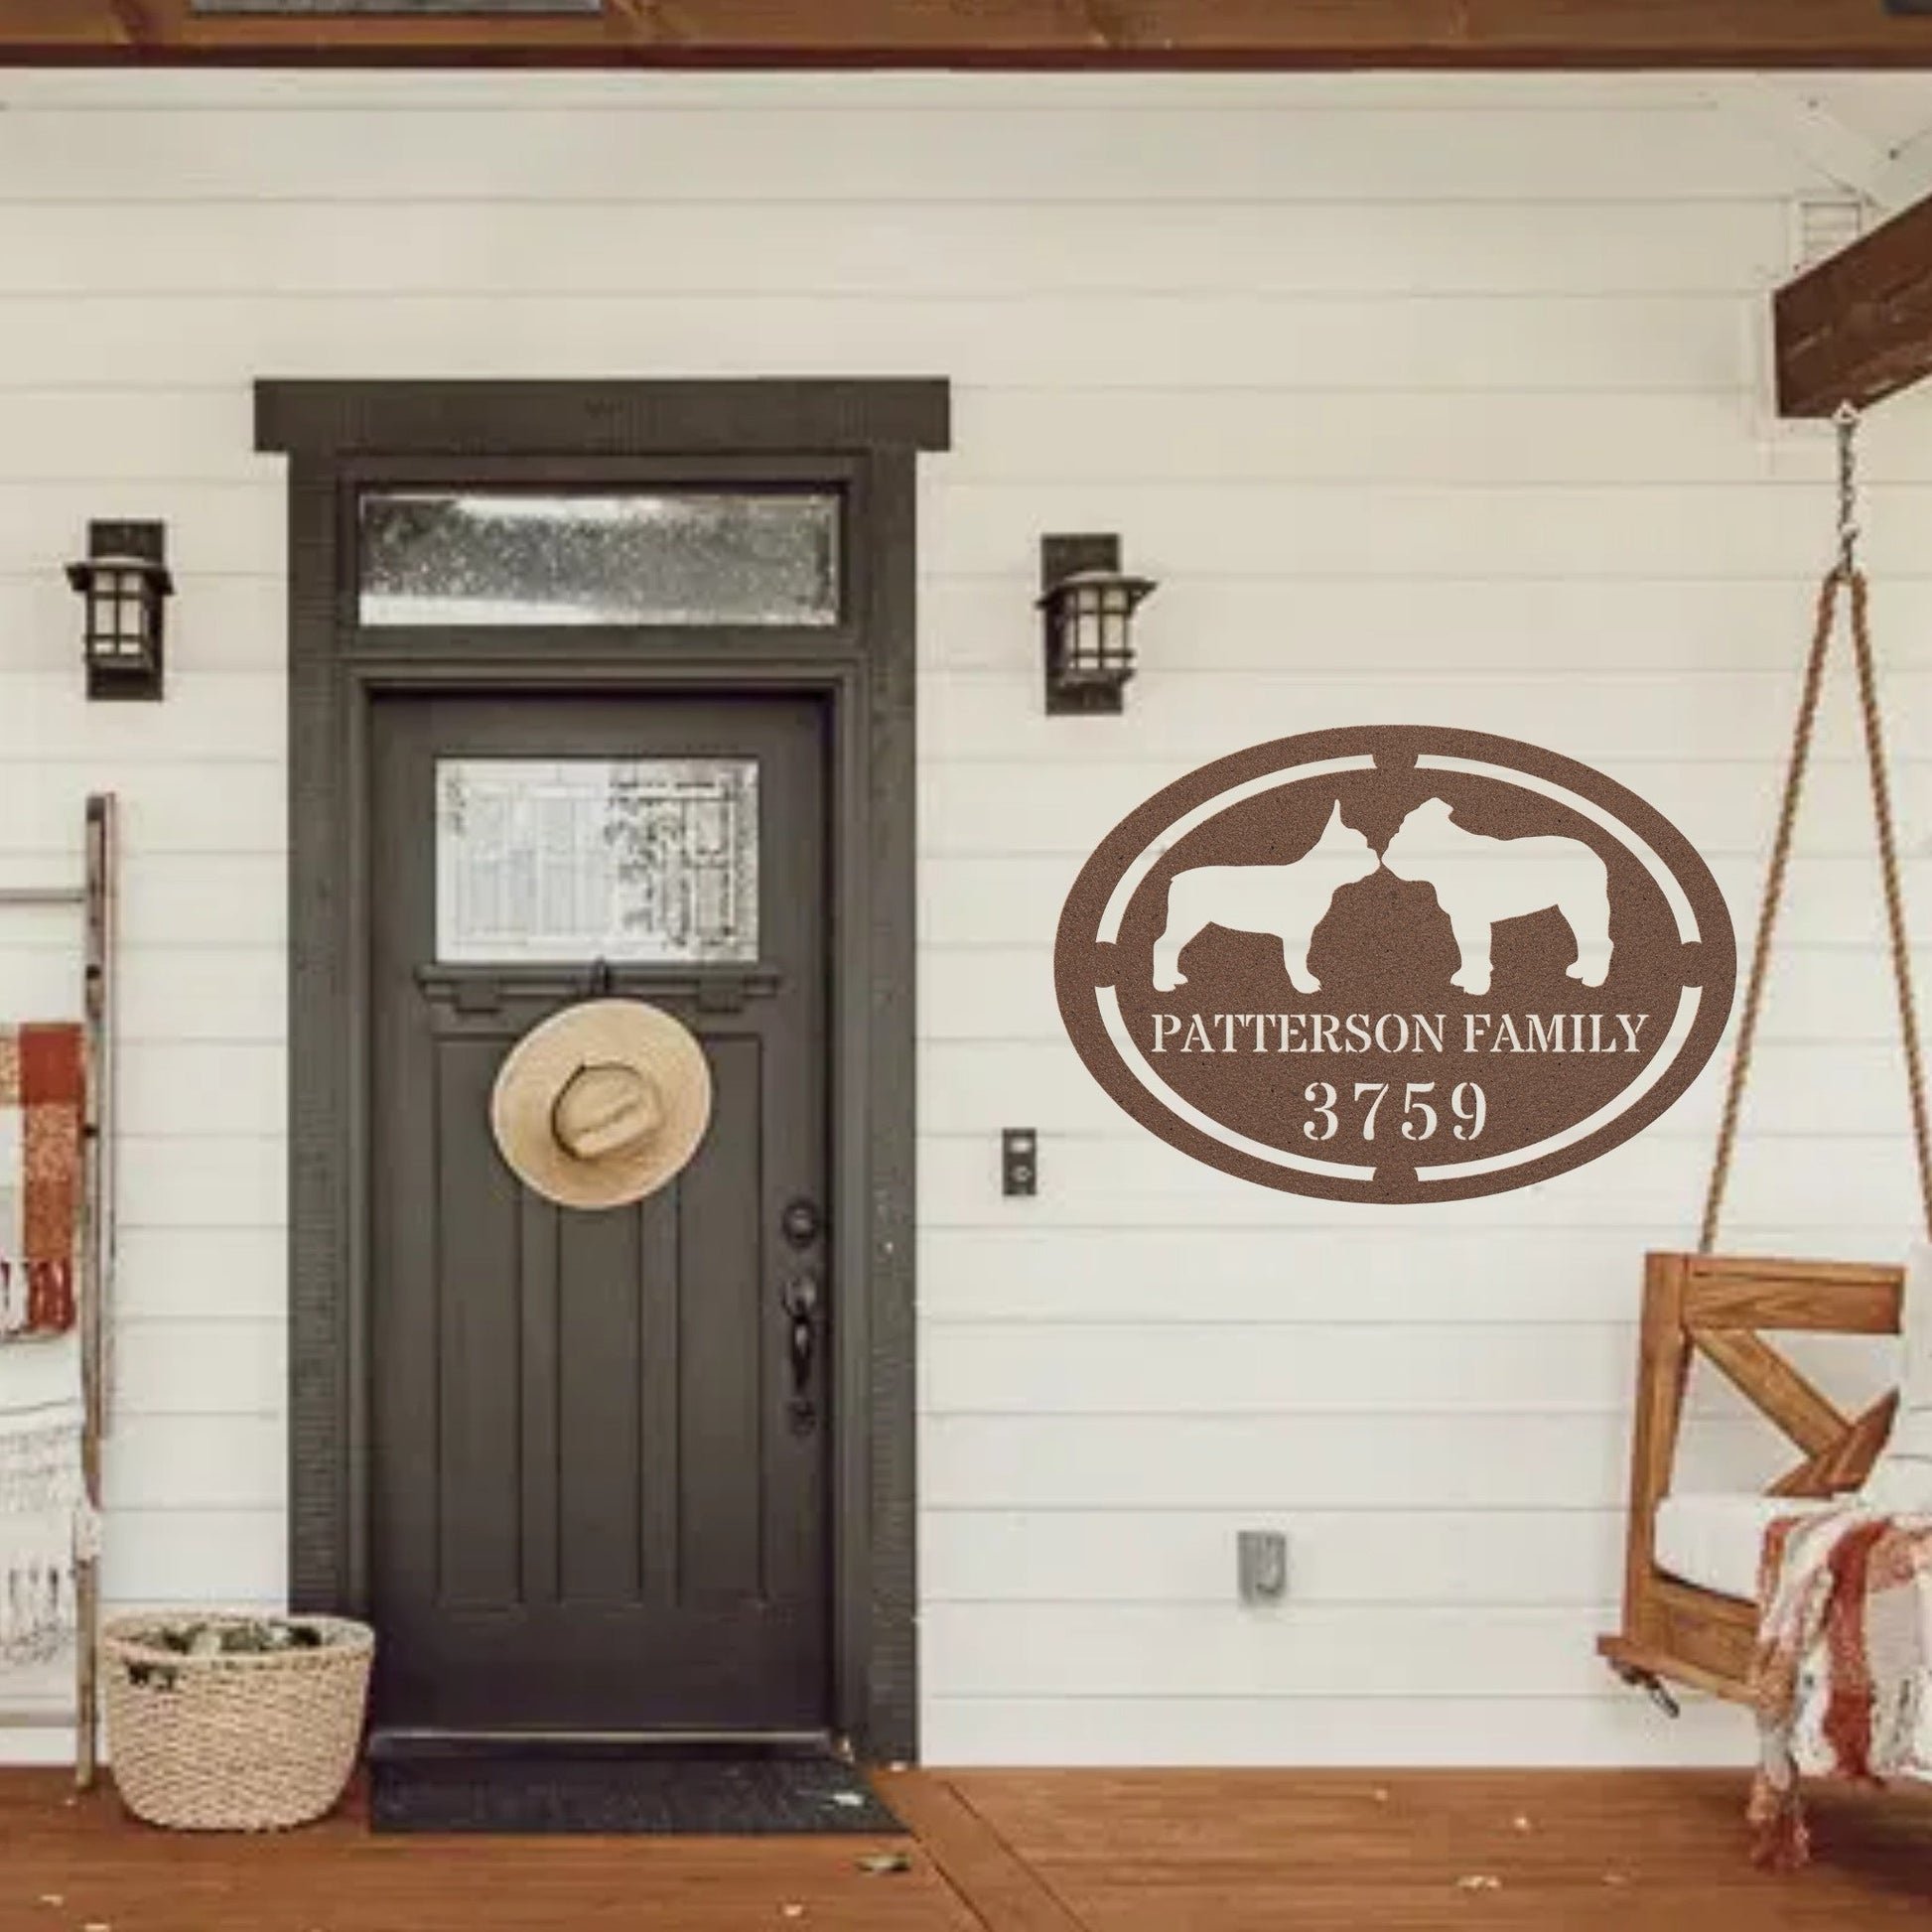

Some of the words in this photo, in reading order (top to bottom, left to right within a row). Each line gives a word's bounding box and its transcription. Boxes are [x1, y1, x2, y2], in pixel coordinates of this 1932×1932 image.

[1152, 1014, 1447, 1052] PATTERSON
[1463, 1014, 1649, 1052] FAMILY
[1304, 1082, 1486, 1140] 3759
